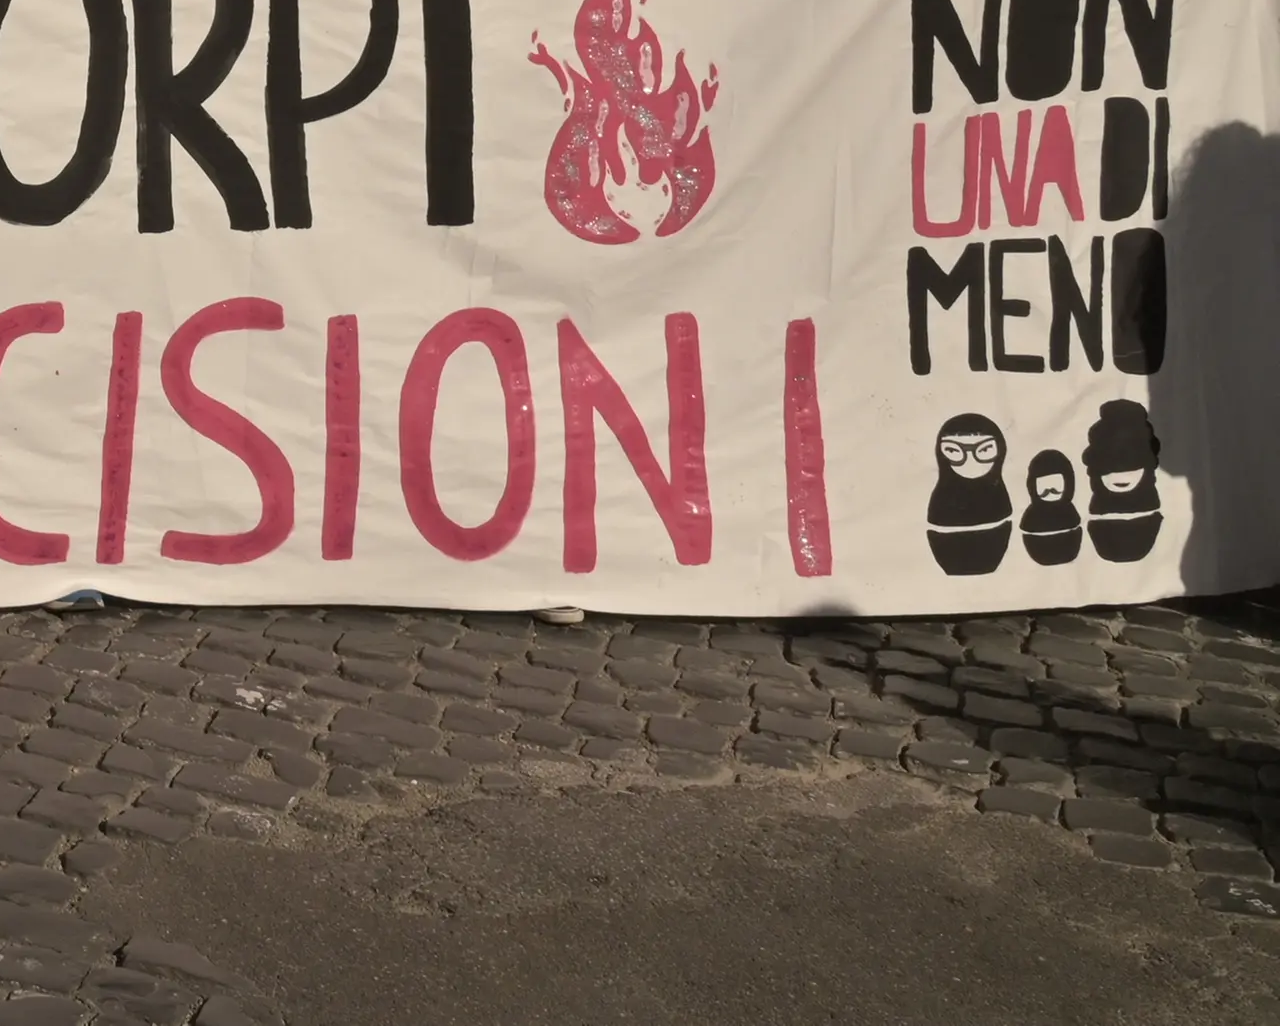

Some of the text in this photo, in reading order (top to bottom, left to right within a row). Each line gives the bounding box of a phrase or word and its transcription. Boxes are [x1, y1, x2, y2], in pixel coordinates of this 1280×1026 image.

[912, 96, 1170, 238] UNA DI
[906, 226, 1168, 376] MENO
